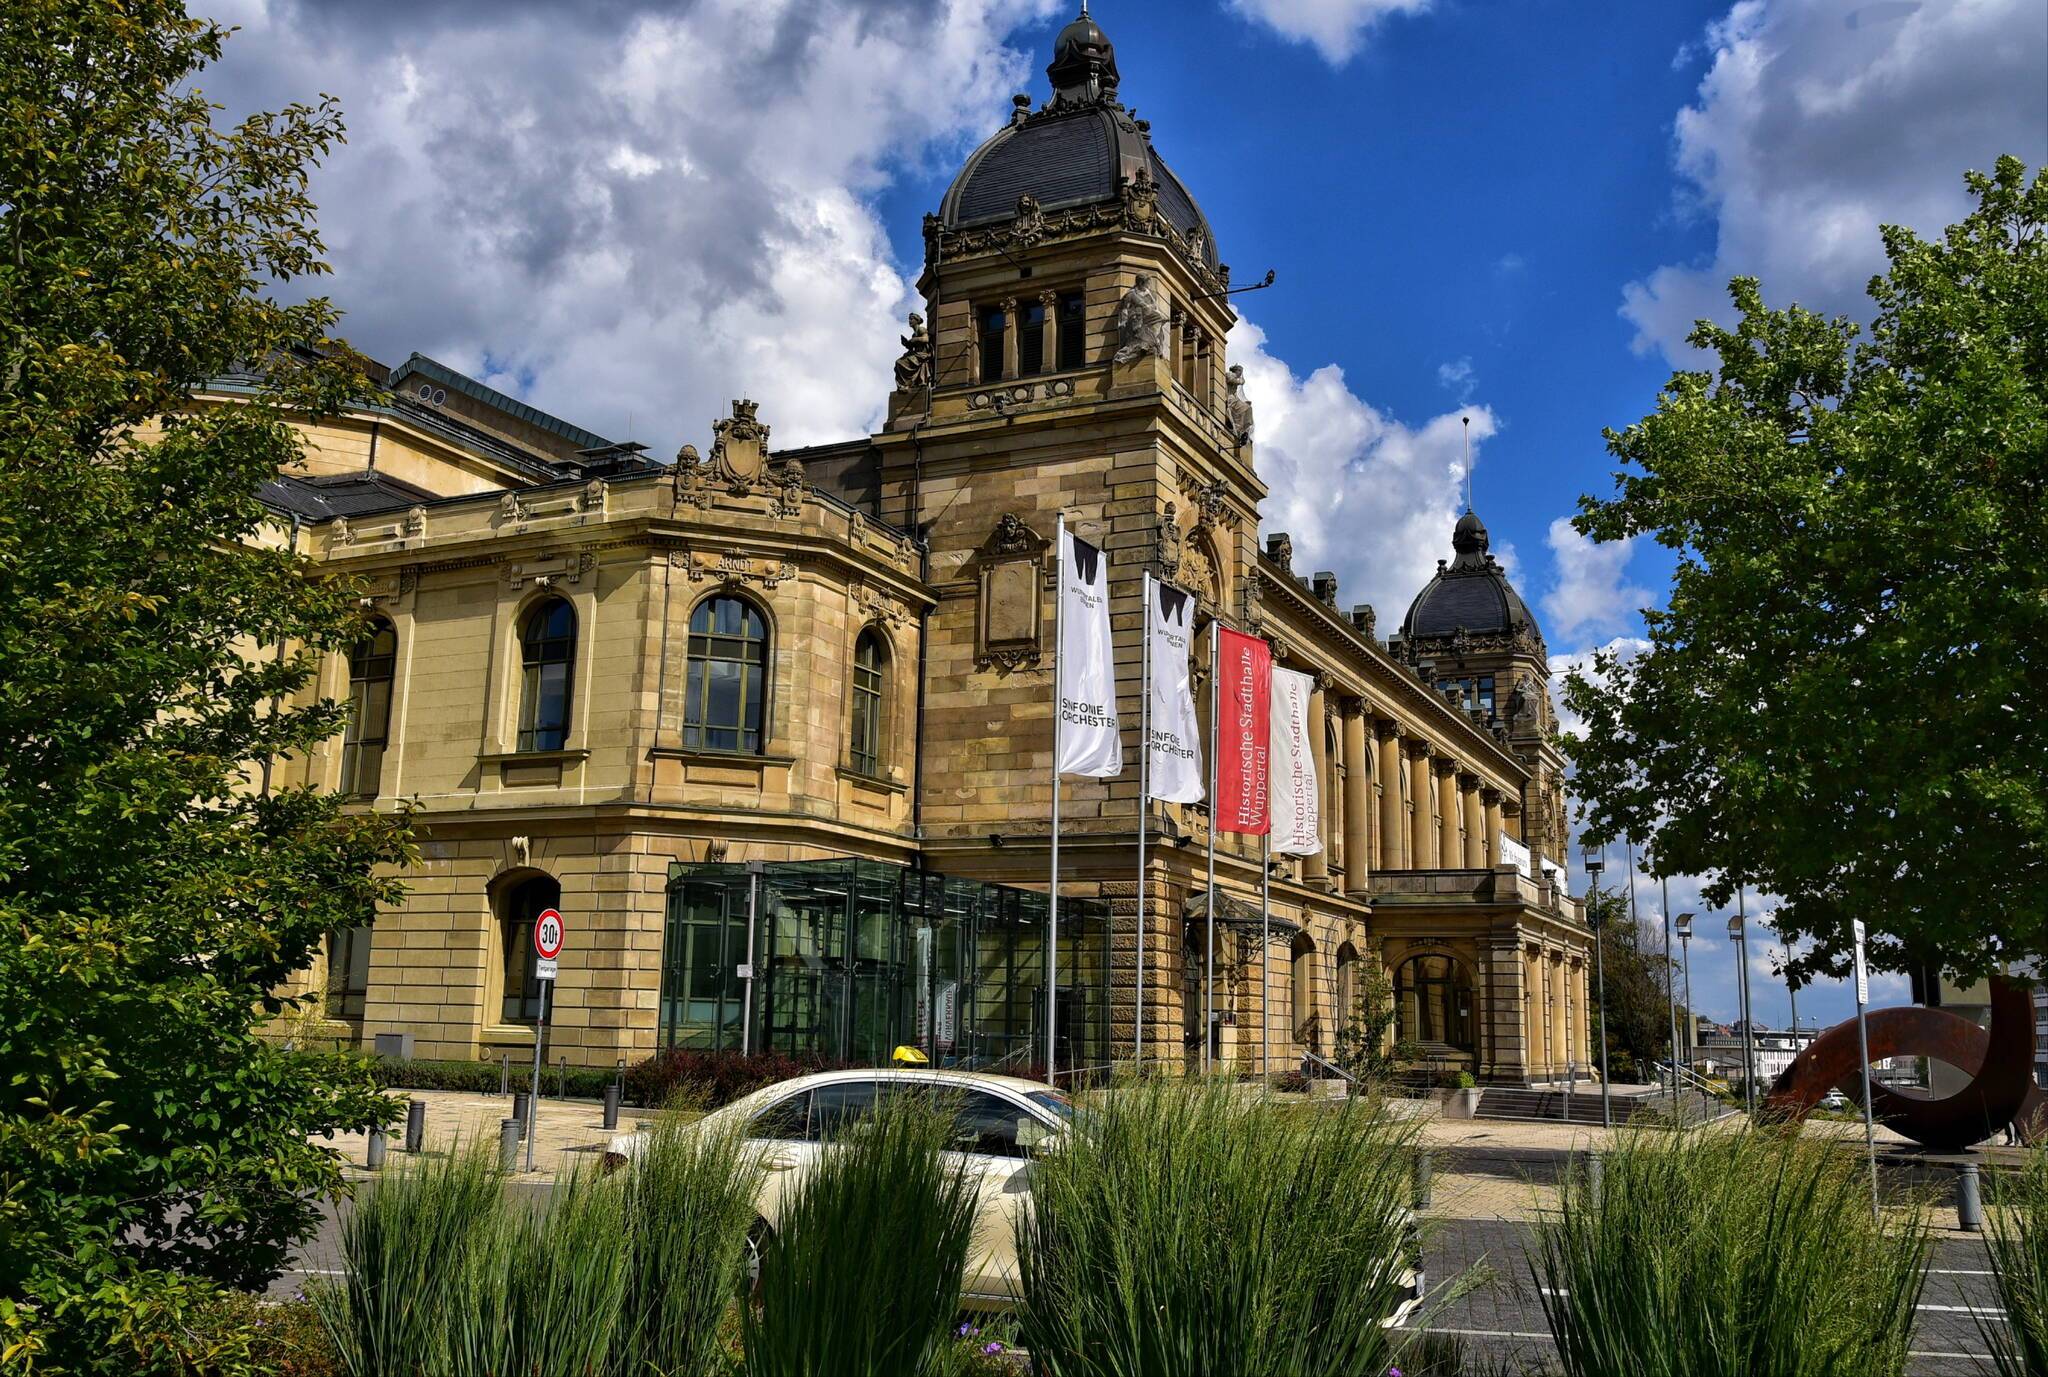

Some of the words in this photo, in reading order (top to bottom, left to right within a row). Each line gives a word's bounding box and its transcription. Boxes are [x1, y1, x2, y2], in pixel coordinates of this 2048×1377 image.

[717, 557, 754, 573] ARNDT
[1239, 646, 1254, 729] Stadthalle
[1290, 683, 1303, 758] Stadthalle
[1238, 730, 1254, 826] Historische
[1249, 745, 1268, 828] Wuppertal
[1291, 760, 1305, 848] Historische
[1304, 773, 1318, 848] Wuppertal
[542, 923, 558, 945] 30t
